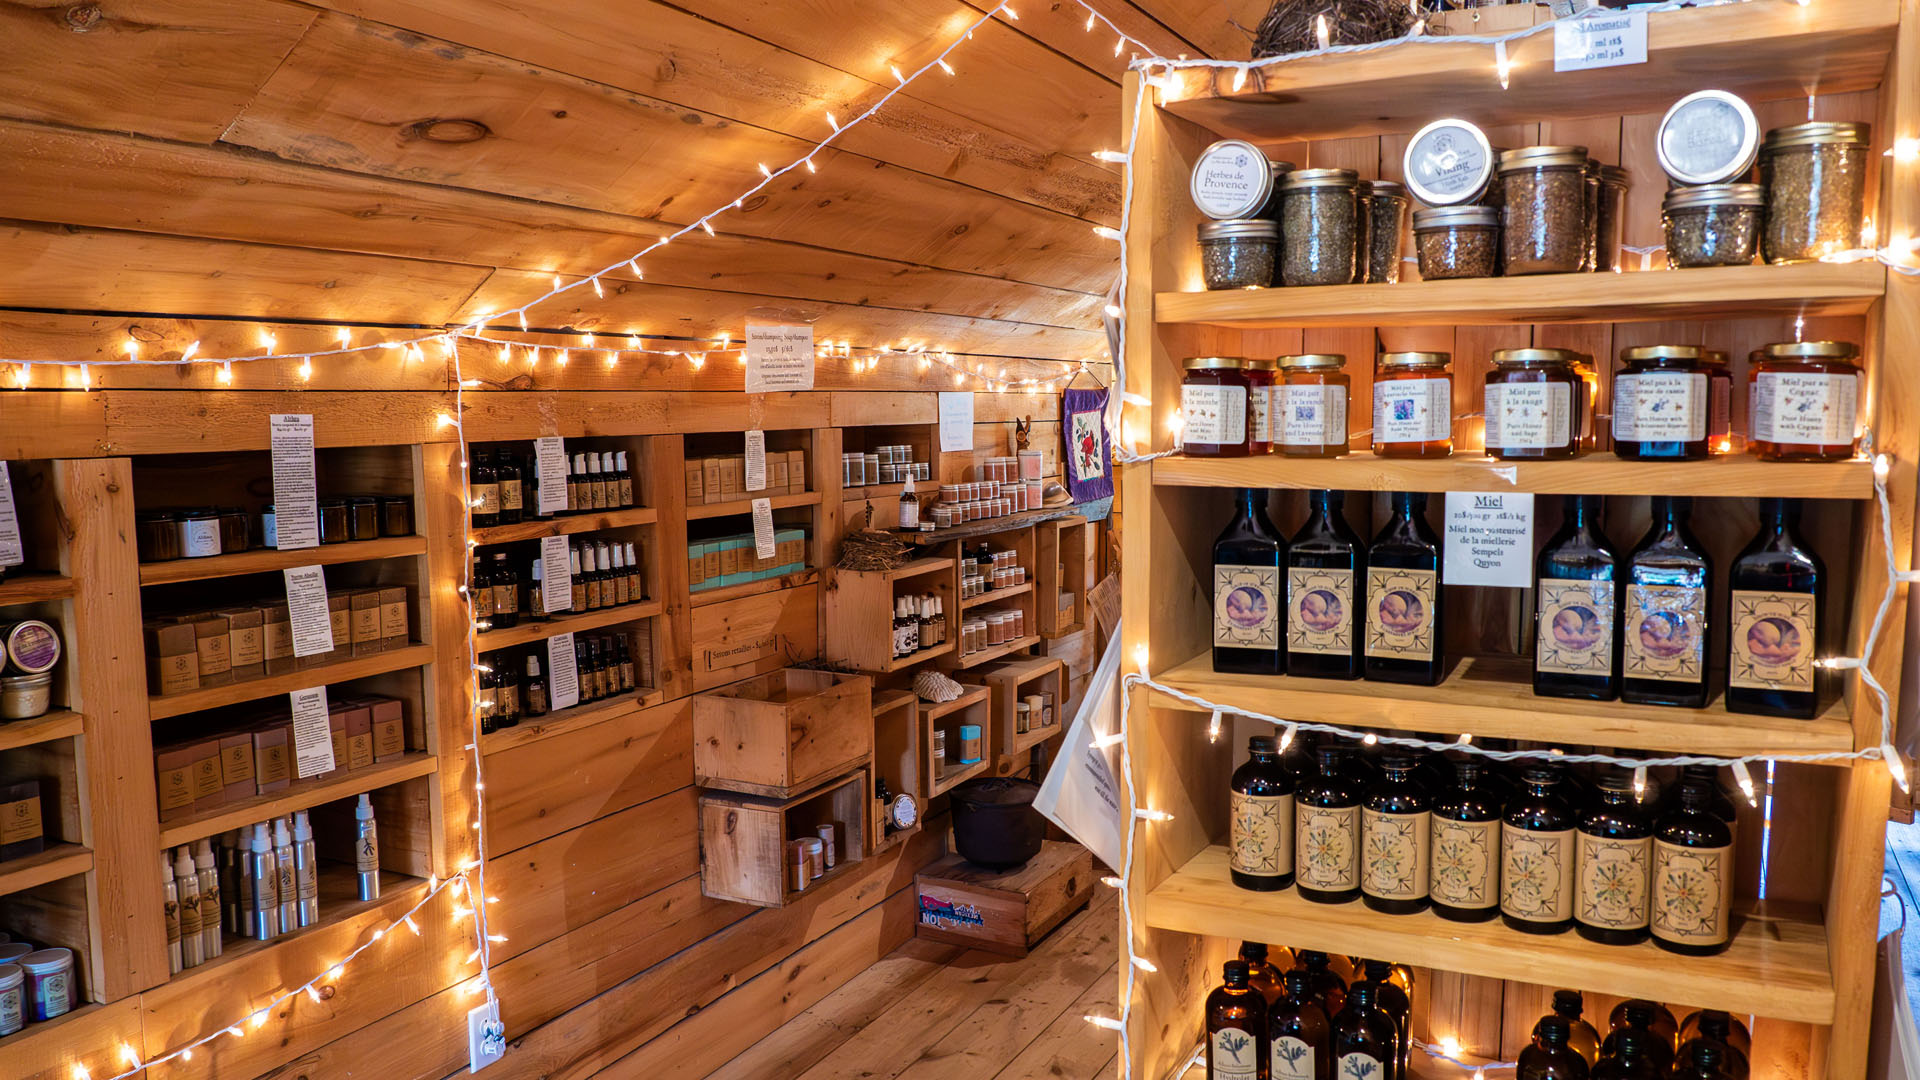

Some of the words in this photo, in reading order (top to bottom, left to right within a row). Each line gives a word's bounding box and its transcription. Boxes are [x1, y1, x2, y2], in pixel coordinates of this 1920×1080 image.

[1595, 37, 1606, 46] ml
[1597, 50, 1608, 60] ml
[1206, 170, 1233, 180] Herbes
[1234, 172, 1244, 180] de
[1204, 178, 1248, 190] Provence
[1782, 378, 1800, 386] Miel
[1789, 388, 1820, 396] Cognac
[1474, 496, 1504, 507] Miel
[1516, 512, 1526, 522] kg
[1448, 525, 1467, 533] Miel
[1460, 536, 1470, 544] de
[1472, 536, 1479, 544] la
[1481, 536, 1516, 546] miellerie
[1472, 546, 1504, 558] Sempels
[1474, 558, 1502, 568] Quyon
